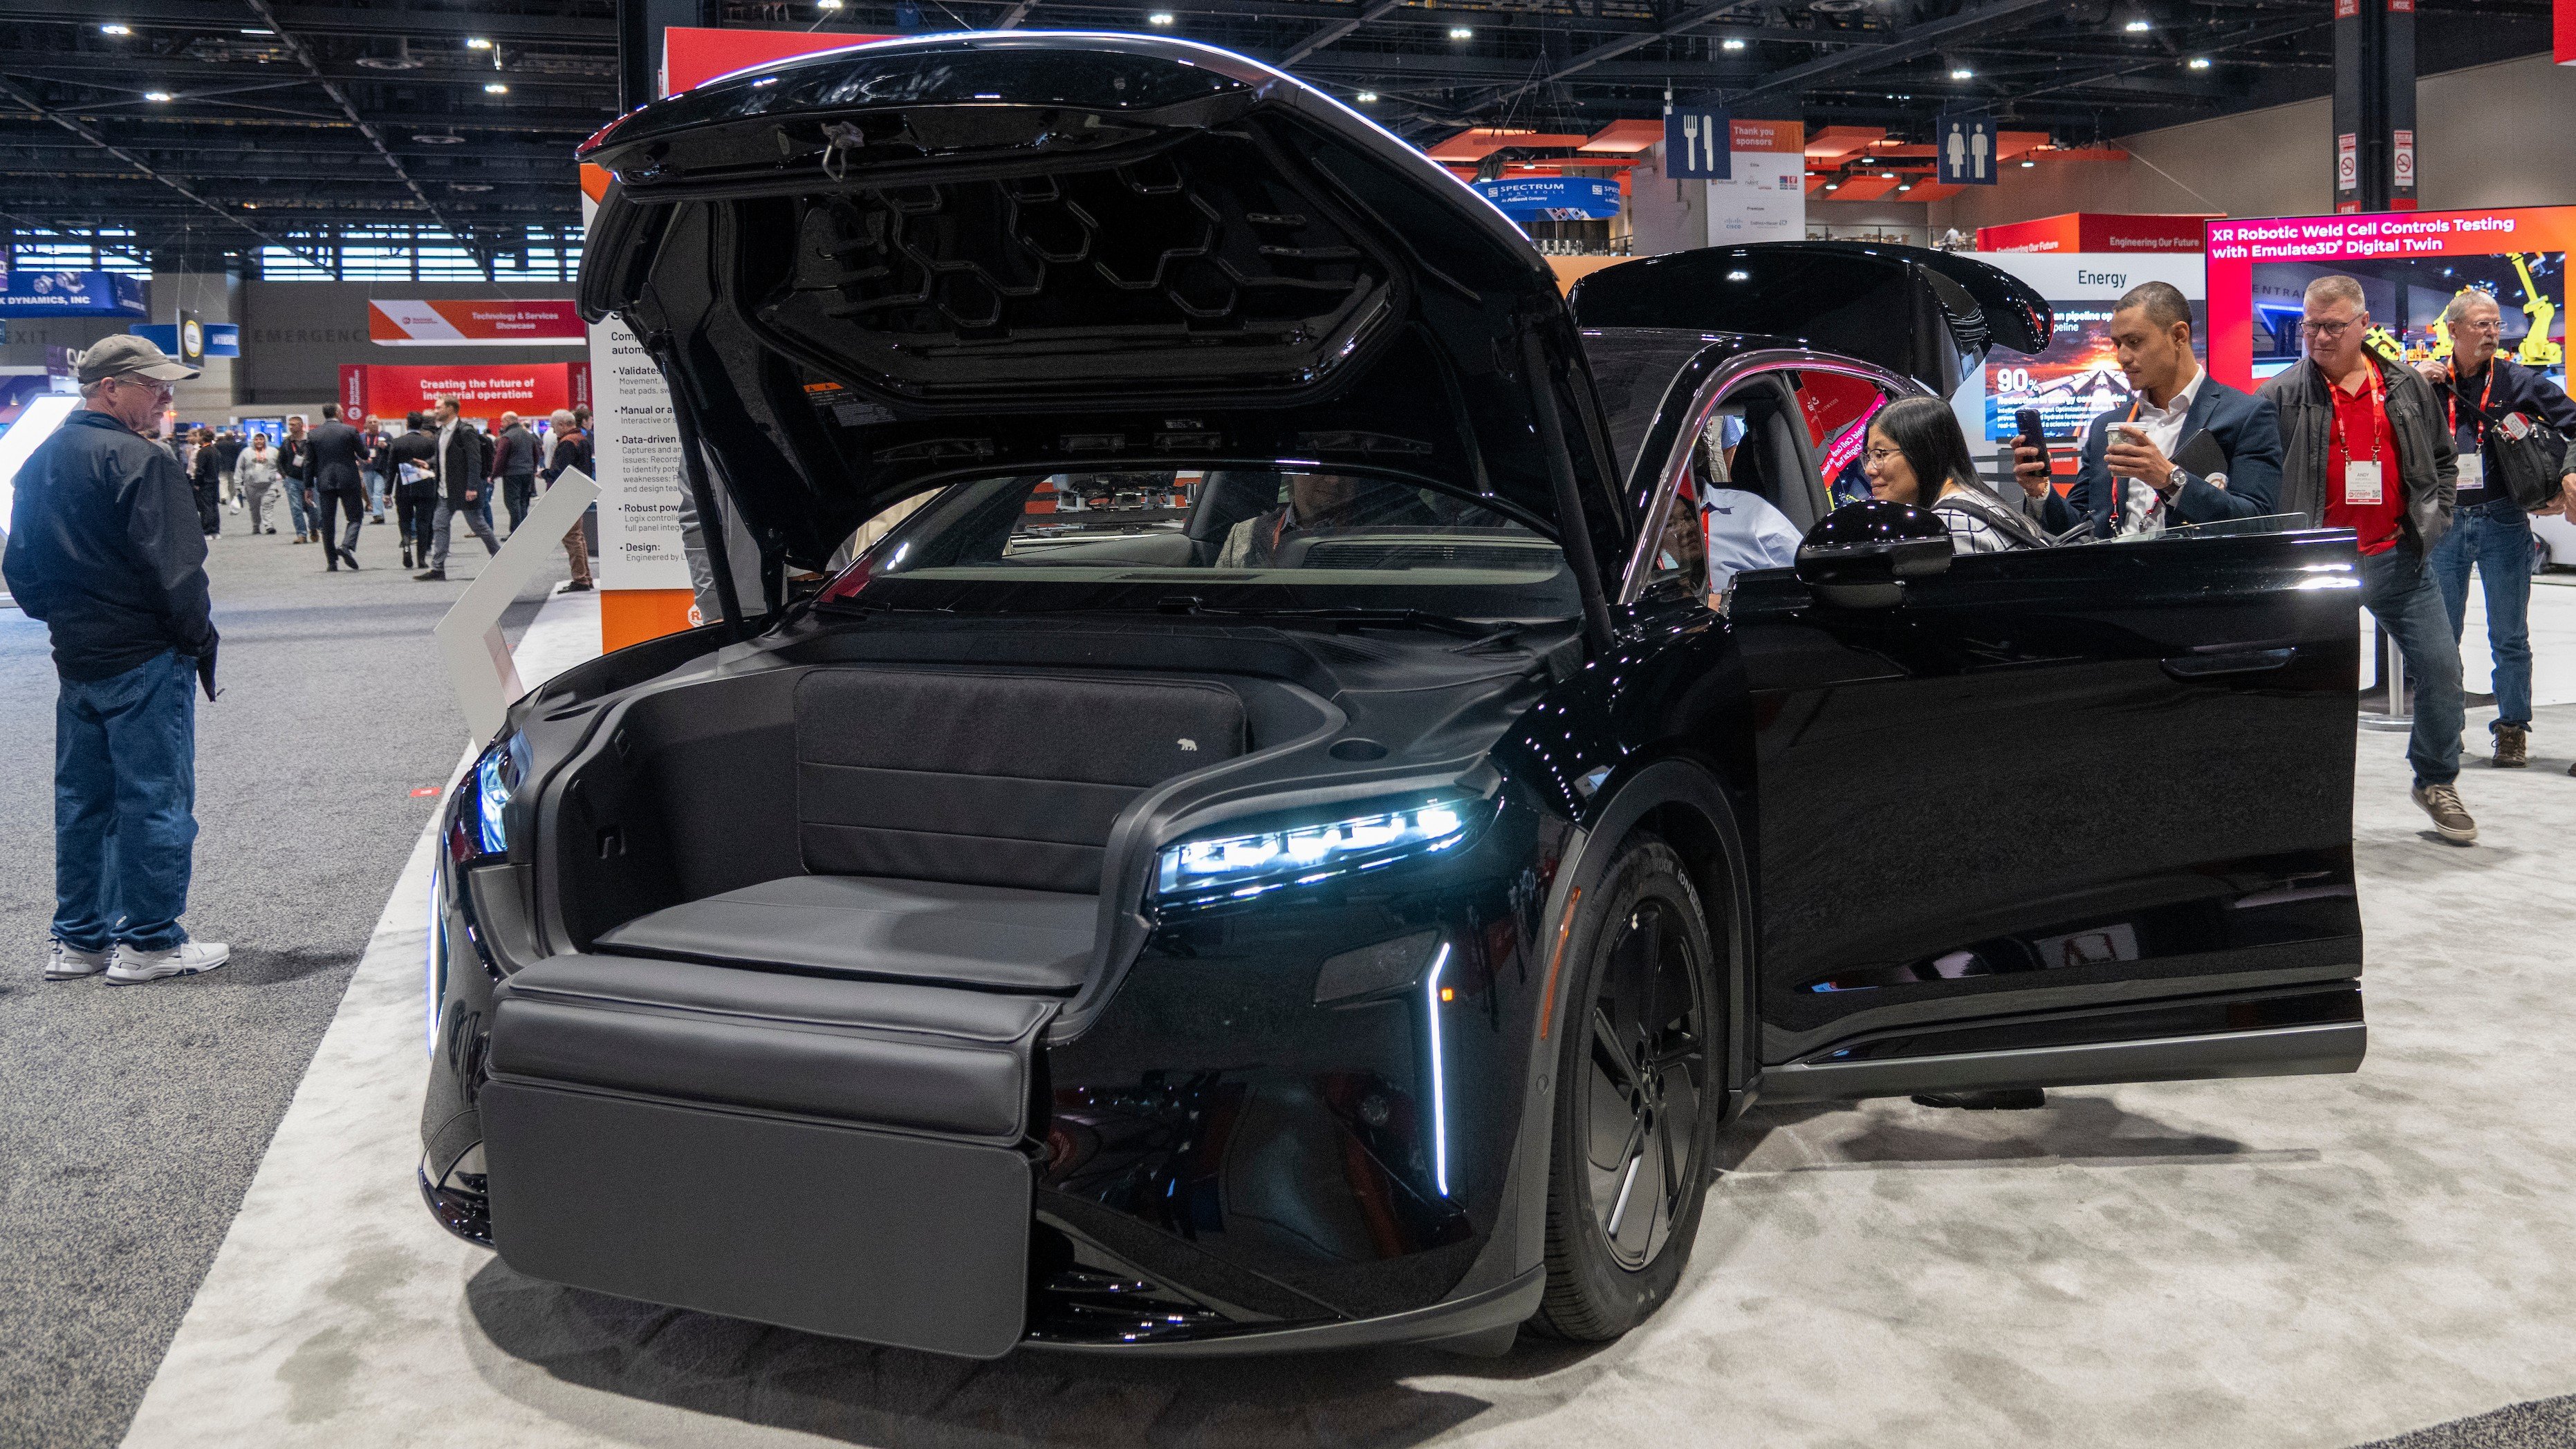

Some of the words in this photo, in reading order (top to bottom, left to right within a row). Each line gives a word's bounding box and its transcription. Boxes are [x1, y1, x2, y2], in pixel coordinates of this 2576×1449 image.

[1734, 127, 1758, 135] Thank
[1760, 129, 1774, 137] you
[1736, 138, 1772, 147] sponsors
[1501, 183, 1564, 192] SPECTRUM
[2212, 229, 2234, 241] XR
[2237, 225, 2299, 241] Robotic
[2301, 223, 2343, 238] Weld
[2347, 222, 2377, 236] Cell
[2381, 219, 2450, 234] Controls
[2453, 216, 2515, 232] Testing
[2028, 243, 2039, 252] Our
[2039, 241, 2059, 250] Future
[2109, 237, 2157, 249] Engineering
[2158, 238, 2173, 247] Our
[2174, 238, 2199, 247] Future
[2212, 245, 2248, 259] with
[2346, 239, 2400, 256] Digital
[2403, 236, 2443, 252] Twin
[2079, 270, 2126, 288] Energy
[2252, 285, 2304, 298] ENTRA
[8, 296, 68, 306] DYNAMICS,
[71, 296, 91, 305] INC
[472, 312, 516, 321] Technology
[2066, 310, 2100, 322] pipeline
[253, 328, 369, 343] EMERGENC
[619, 366, 660, 375] Validates
[420, 380, 467, 390] Creating
[469, 379, 487, 389] the
[489, 379, 522, 388] future
[523, 378, 535, 387] of
[423, 390, 475, 400] indtrial
[477, 389, 533, 401] operations
[1997, 395, 2038, 404] Reduction
[2048, 396, 2075, 405] energy
[621, 406, 653, 414] Manual
[2055, 405, 2088, 413] Optimization
[622, 436, 676, 444] Data-driven
[622, 447, 656, 455] Captures
[632, 466, 661, 474] identify
[639, 485, 664, 494] design
[624, 504, 657, 512] Robust
[624, 515, 645, 523] Logix
[626, 543, 660, 552] Design:
[627, 554, 669, 562] Engineered
[671, 554, 679, 562] by
